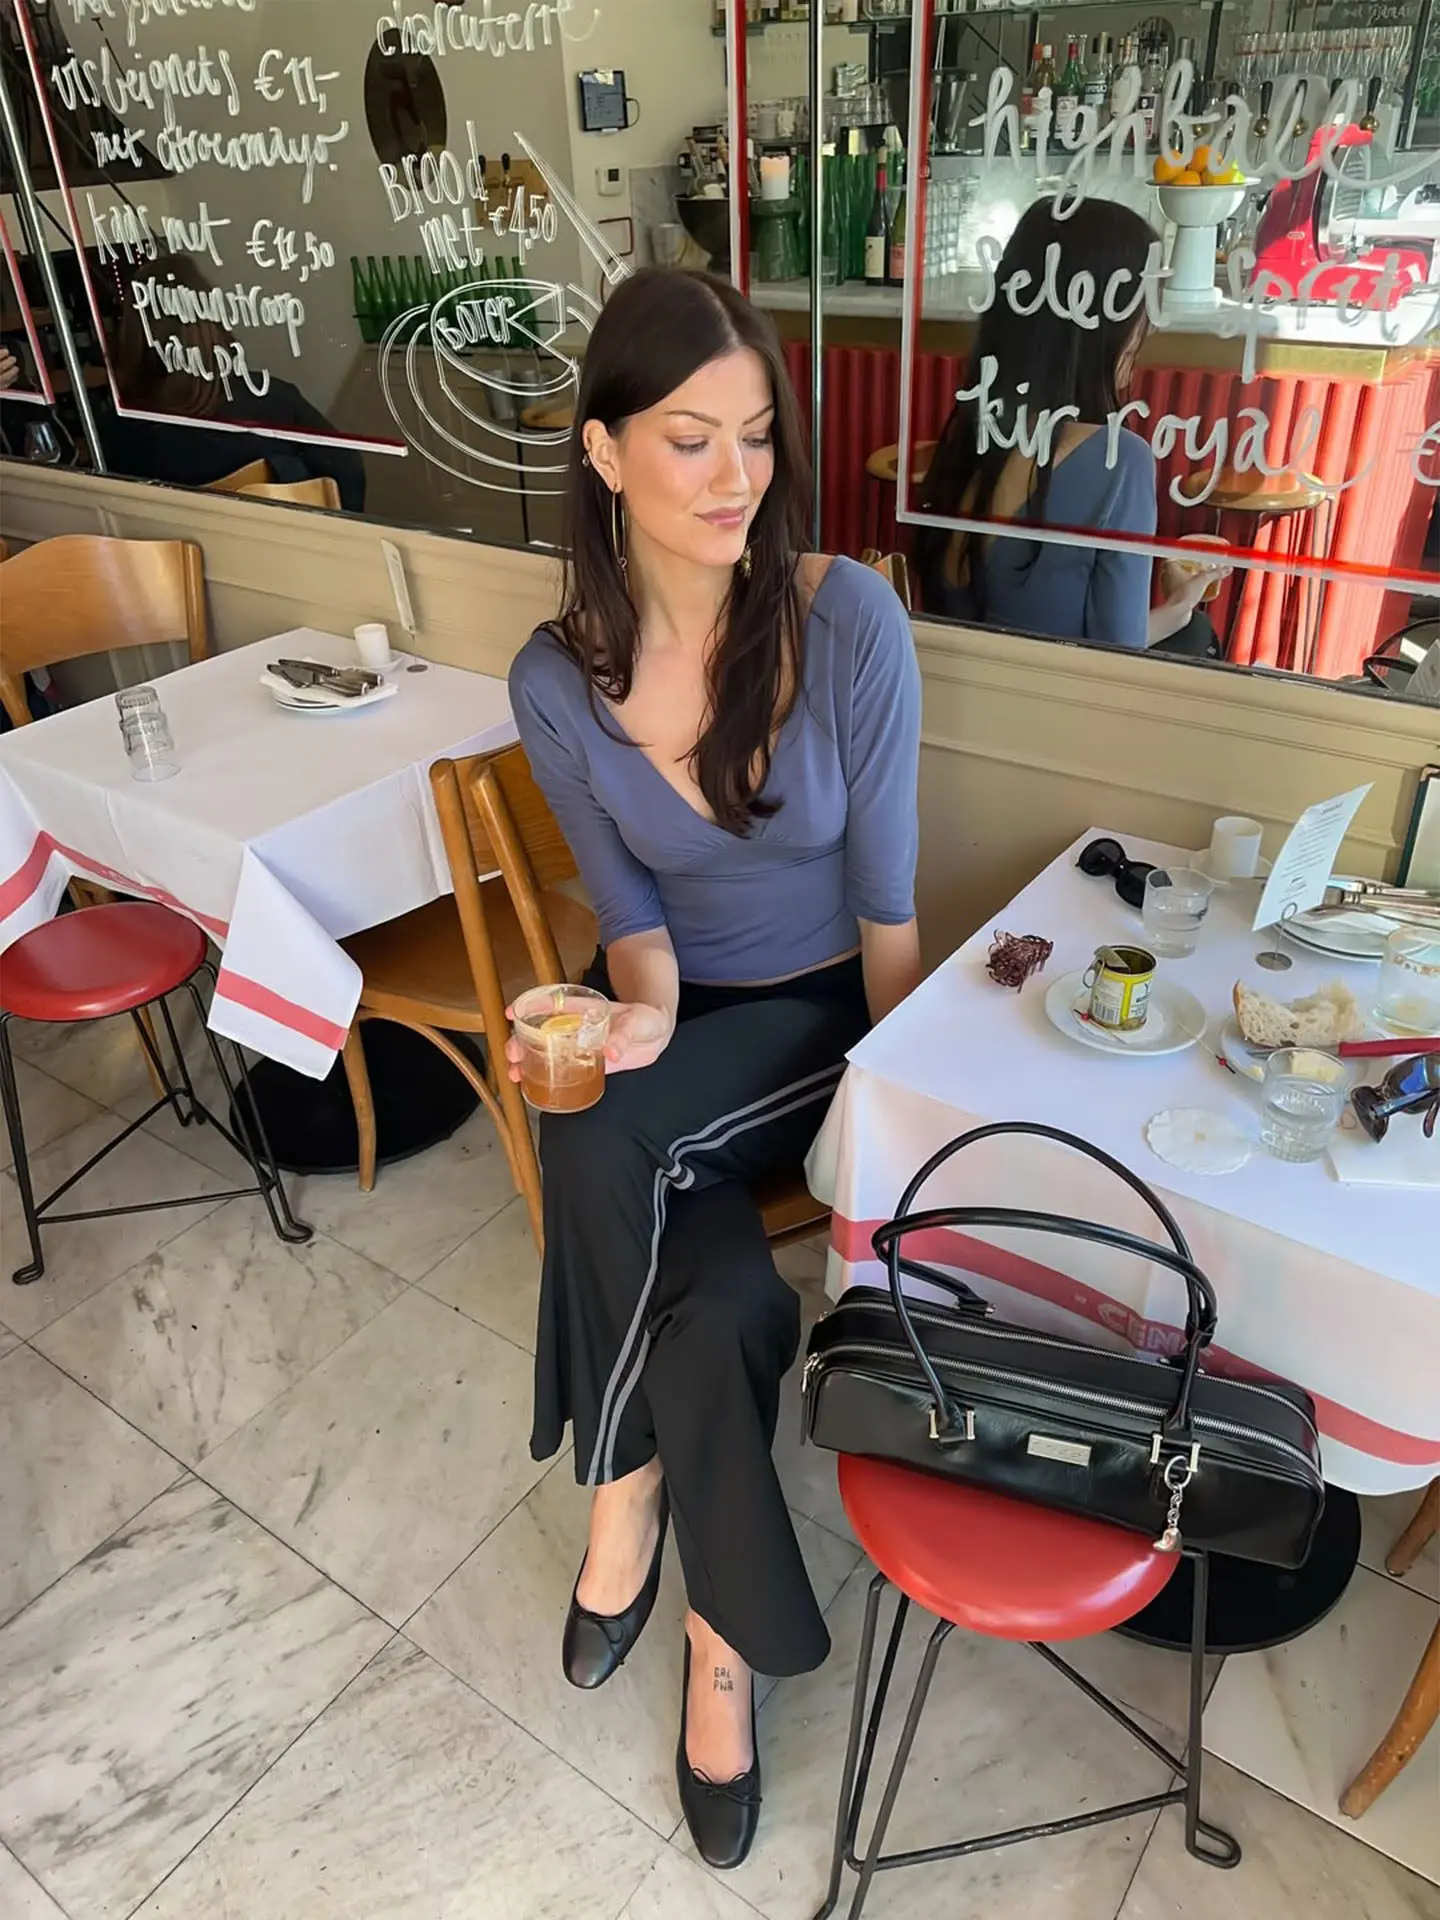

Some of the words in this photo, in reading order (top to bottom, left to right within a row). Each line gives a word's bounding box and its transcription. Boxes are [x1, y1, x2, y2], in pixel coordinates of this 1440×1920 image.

[90, 127, 146, 168] met
[161, 201, 232, 267] met
[420, 207, 484, 274] met
[968, 235, 1175, 330] Select
[956, 355, 1080, 467] kir
